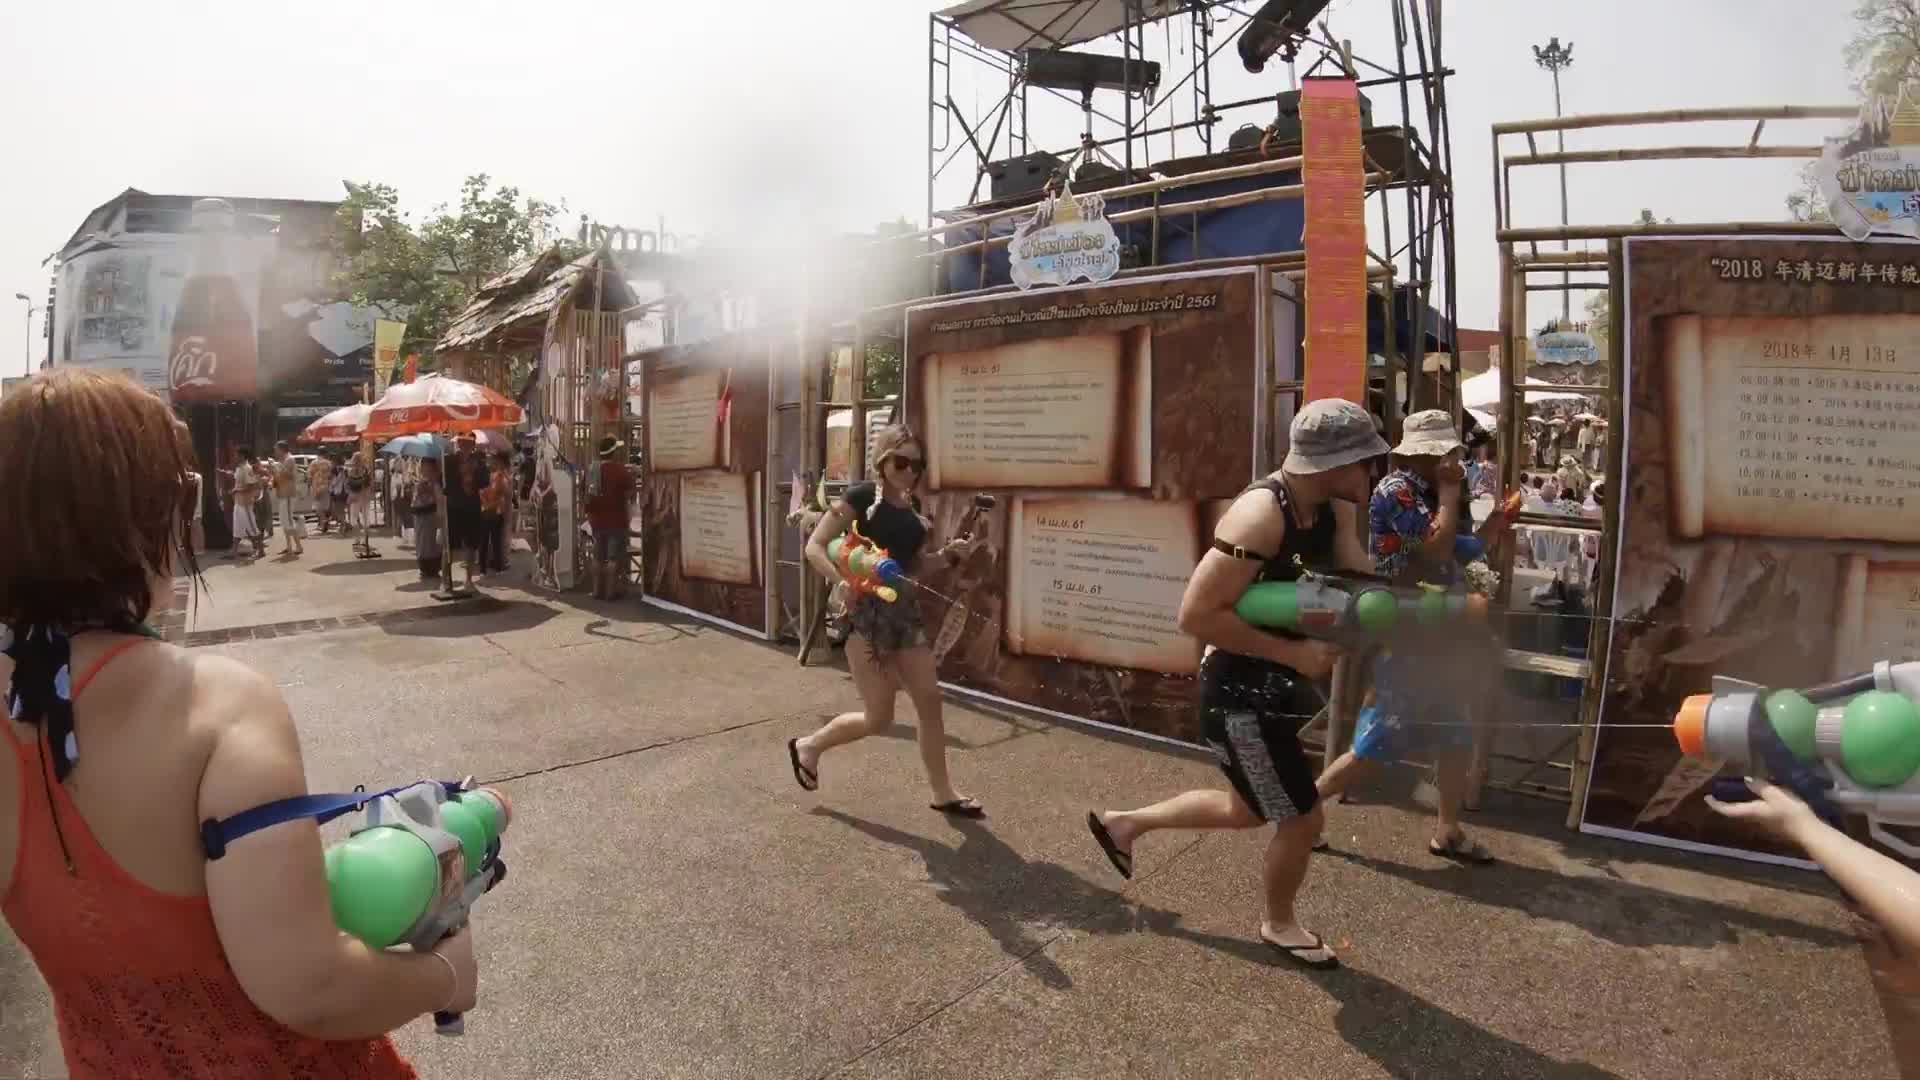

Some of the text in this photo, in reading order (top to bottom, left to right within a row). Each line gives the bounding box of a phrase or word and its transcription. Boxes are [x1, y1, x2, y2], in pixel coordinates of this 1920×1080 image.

[1141, 293, 1185, 312] ประจำปี
[1186, 294, 1217, 309] 2561
[1072, 519, 1085, 529] 61
[1052, 579, 1063, 590] 15
[1089, 584, 1102, 595] 61
